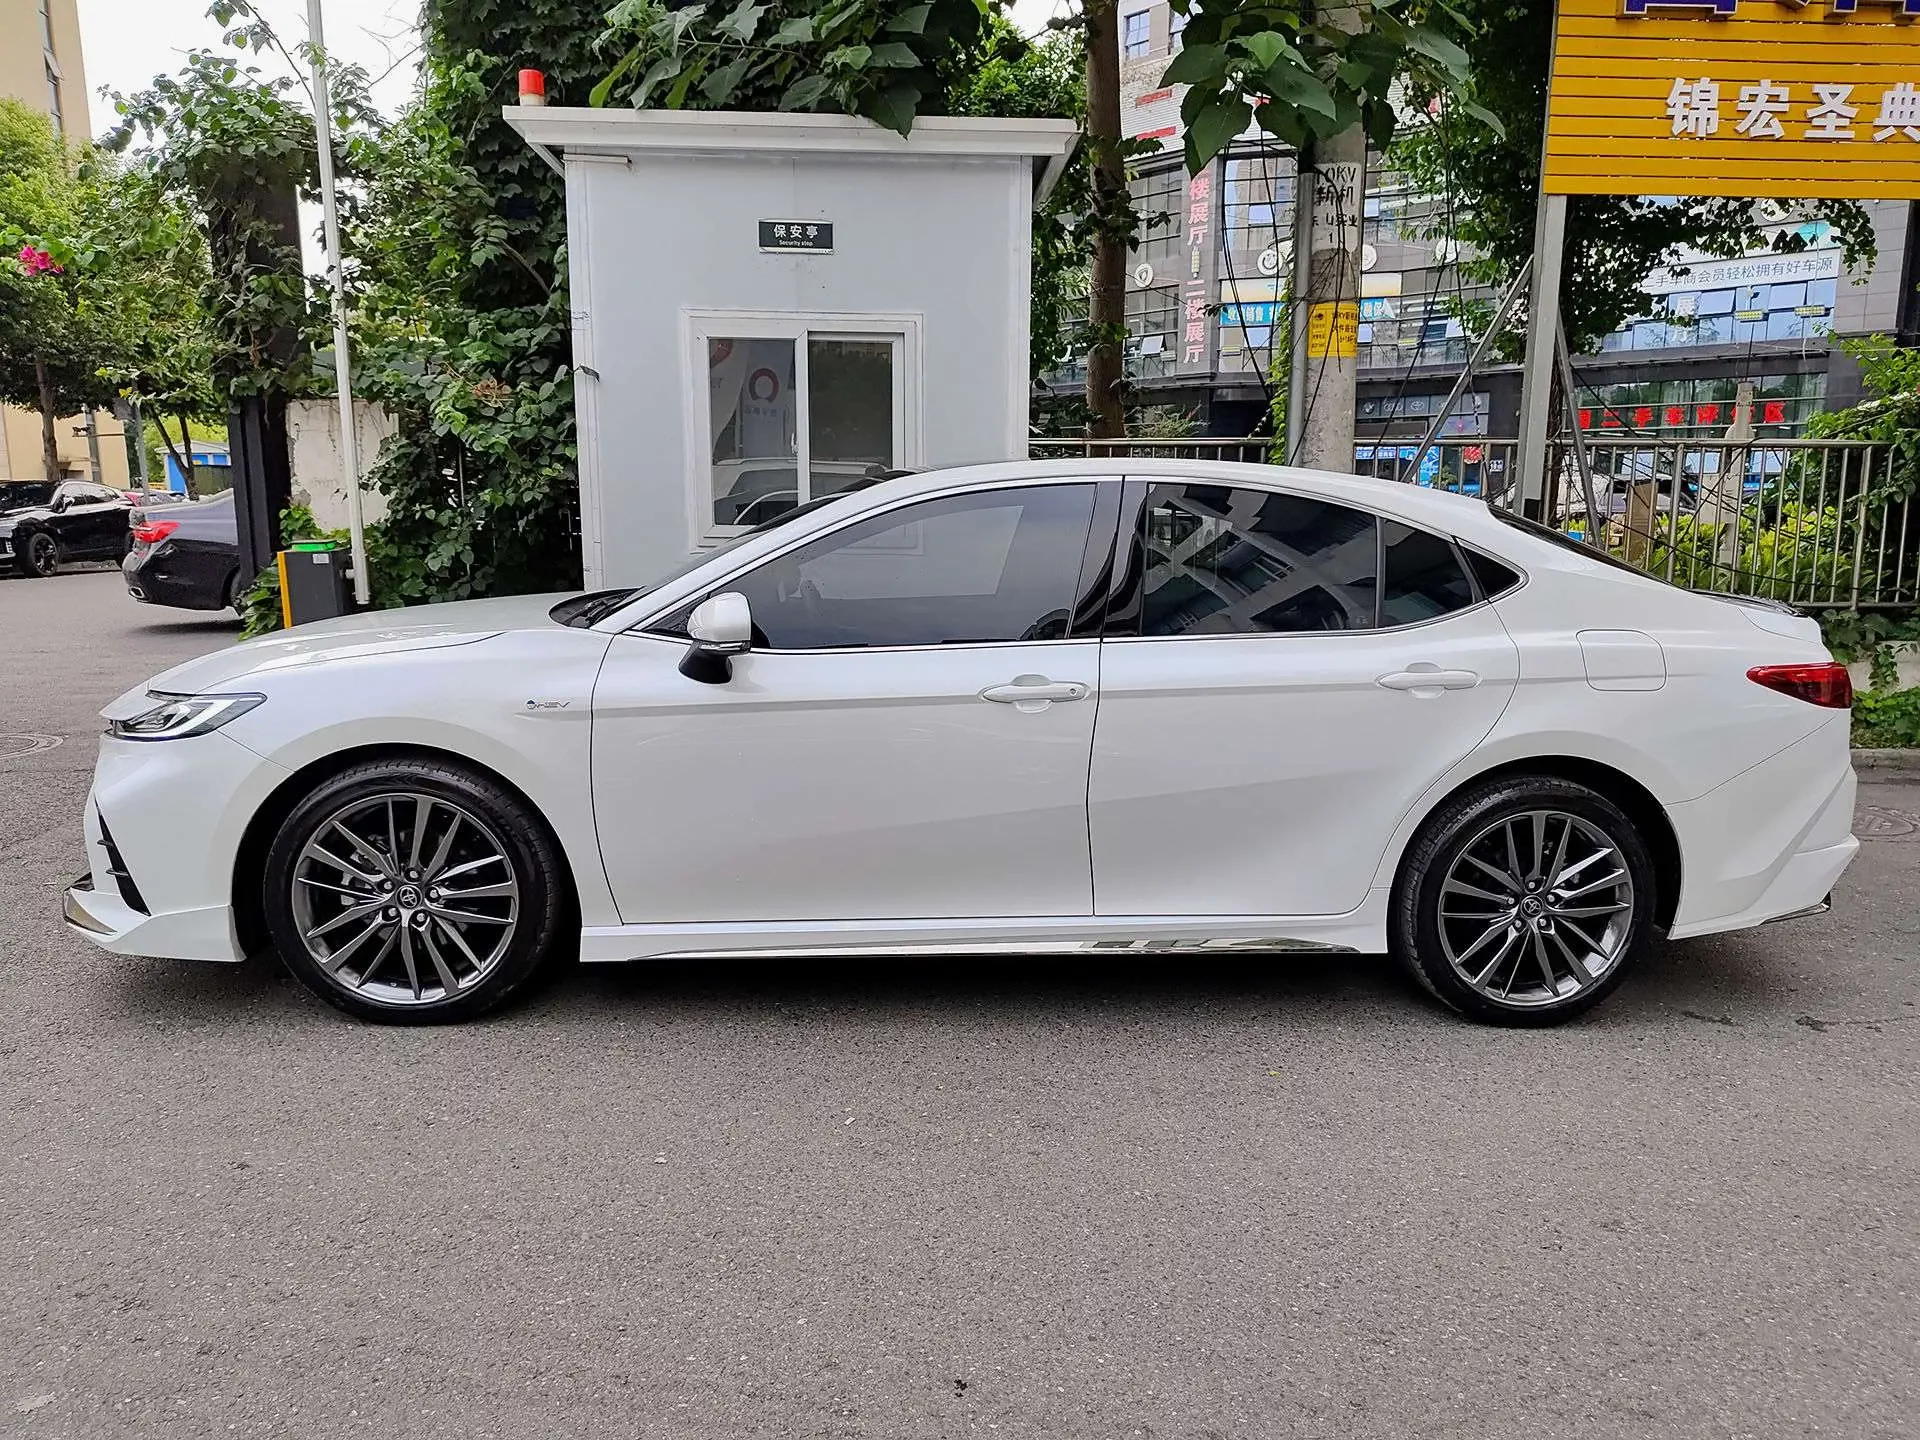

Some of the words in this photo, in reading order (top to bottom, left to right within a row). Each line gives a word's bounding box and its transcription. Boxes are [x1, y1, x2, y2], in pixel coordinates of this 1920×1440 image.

[1665, 77, 1920, 142] 锦宏圣典
[773, 224, 818, 239] 保安亭
[1183, 279, 1206, 364] 二楼展厅
